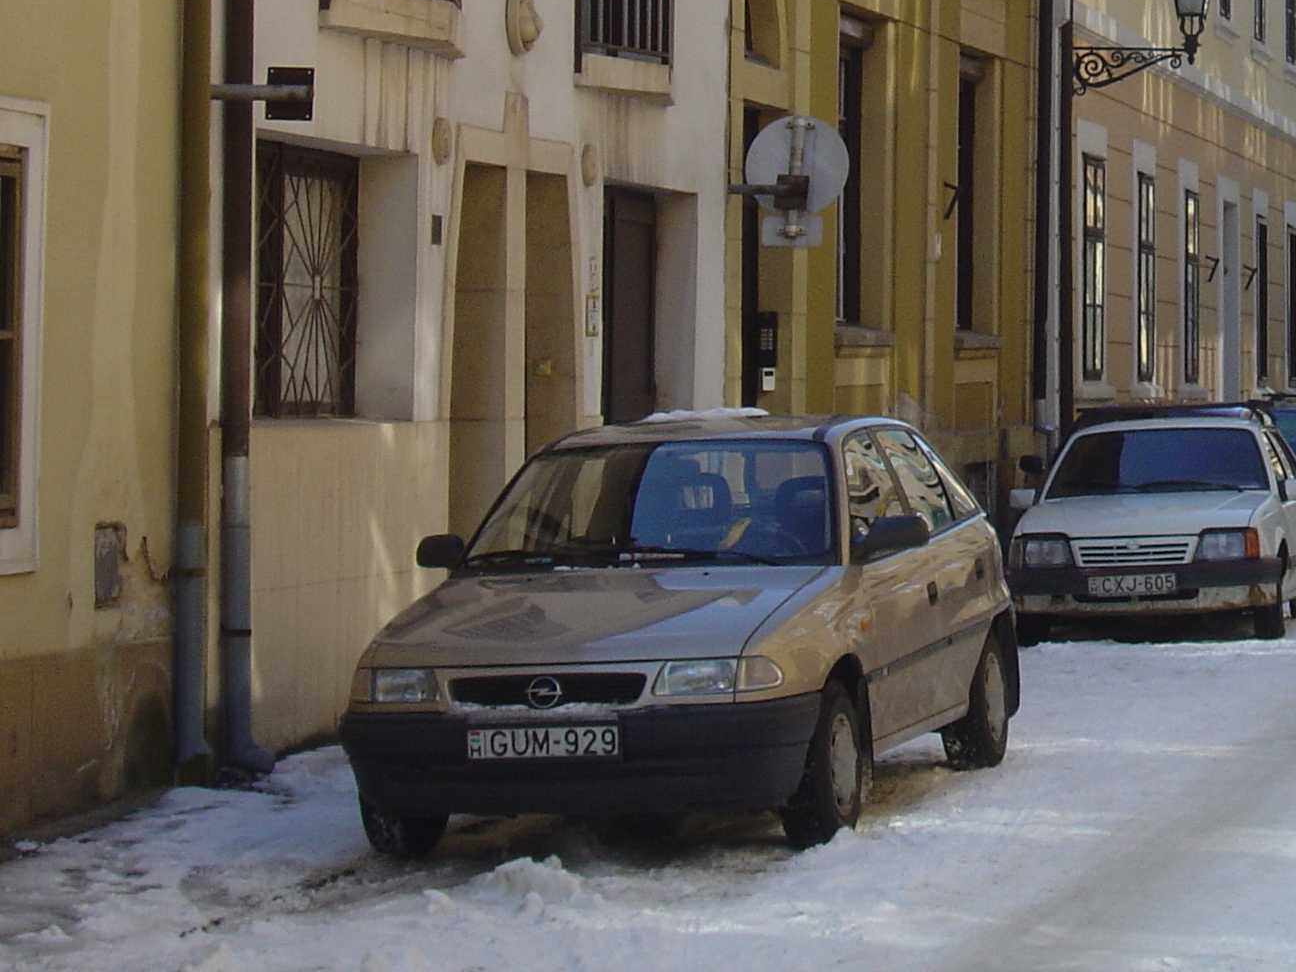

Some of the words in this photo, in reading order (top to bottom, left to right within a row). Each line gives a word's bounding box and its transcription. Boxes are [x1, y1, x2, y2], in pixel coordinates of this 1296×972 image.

[1102, 575, 1175, 593] CXJ-605
[470, 745, 482, 757] H
[490, 729, 616, 757] GUM-929
